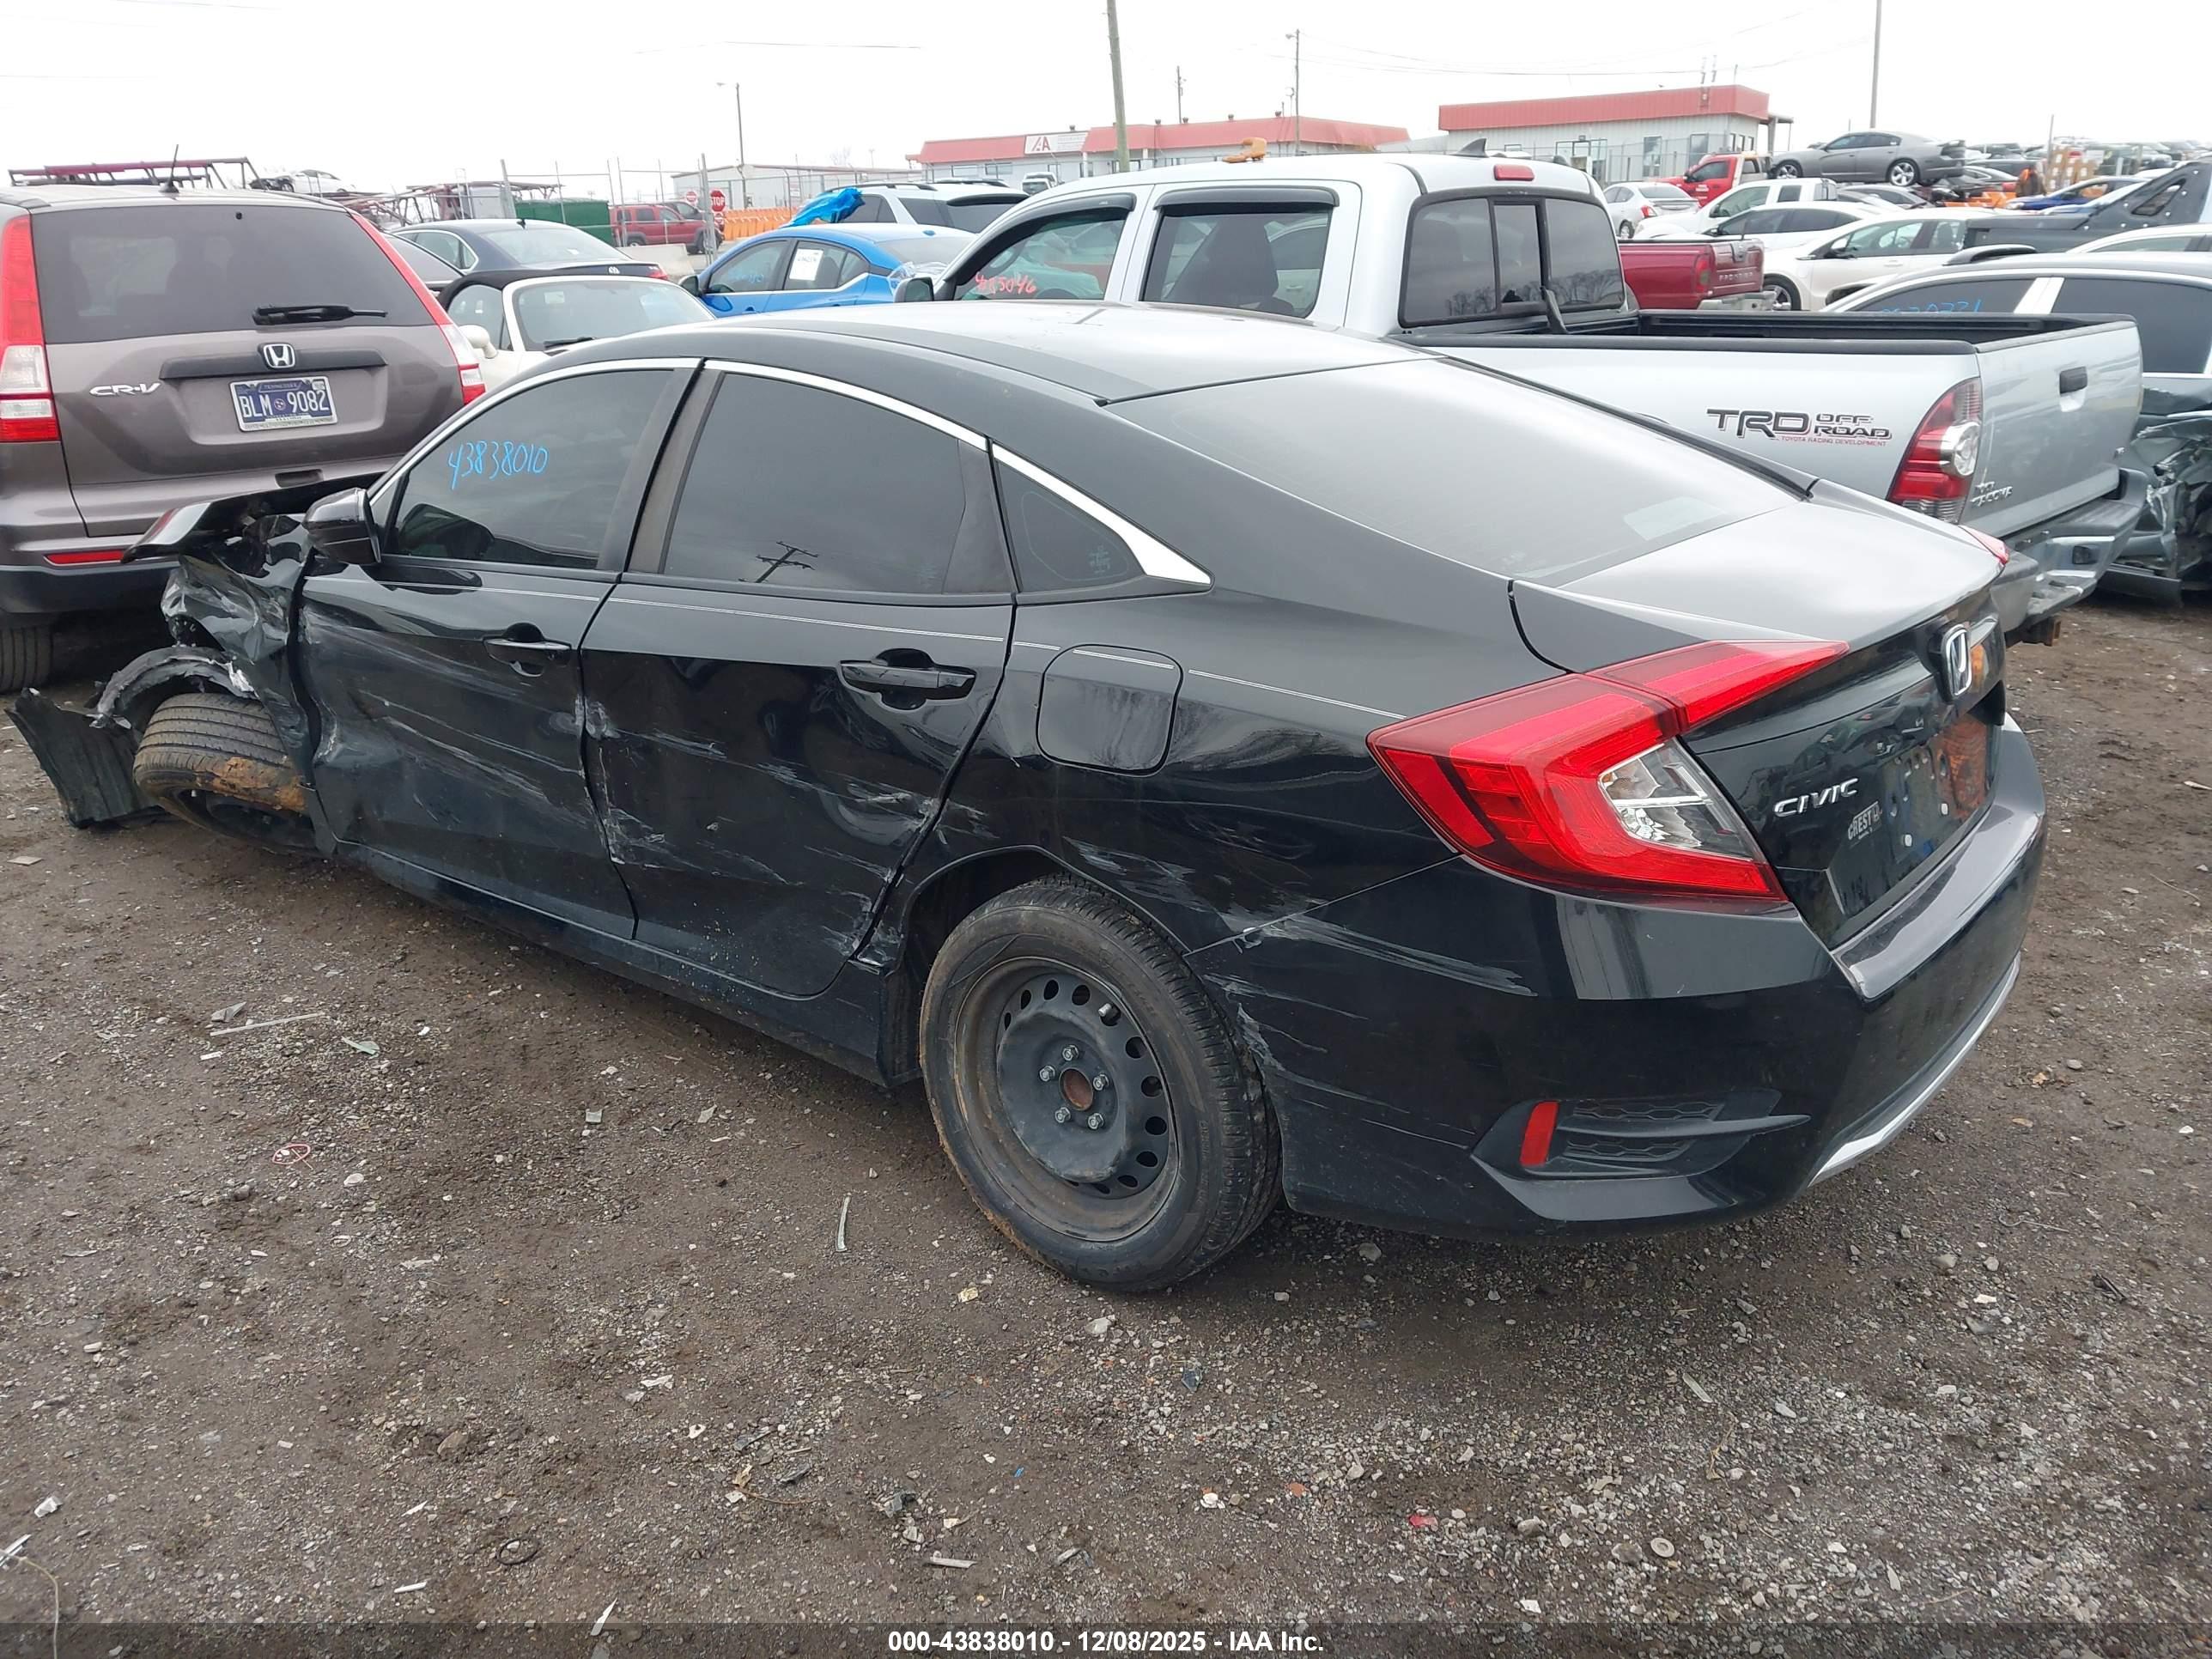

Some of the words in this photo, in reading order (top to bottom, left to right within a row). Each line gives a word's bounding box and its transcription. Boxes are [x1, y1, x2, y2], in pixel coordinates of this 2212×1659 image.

[89, 383, 161, 396] CR-V
[239, 394, 273, 418] BLM
[287, 390, 330, 413] 9082
[1706, 408, 1811, 439] TRD
[1815, 413, 1874, 425] OFF
[1814, 425, 1893, 440] ROAD
[1835, 438, 1887, 447] DEVELOPMENT
[448, 441, 548, 490] 43838010
[1774, 777, 1858, 817] CIVIC
